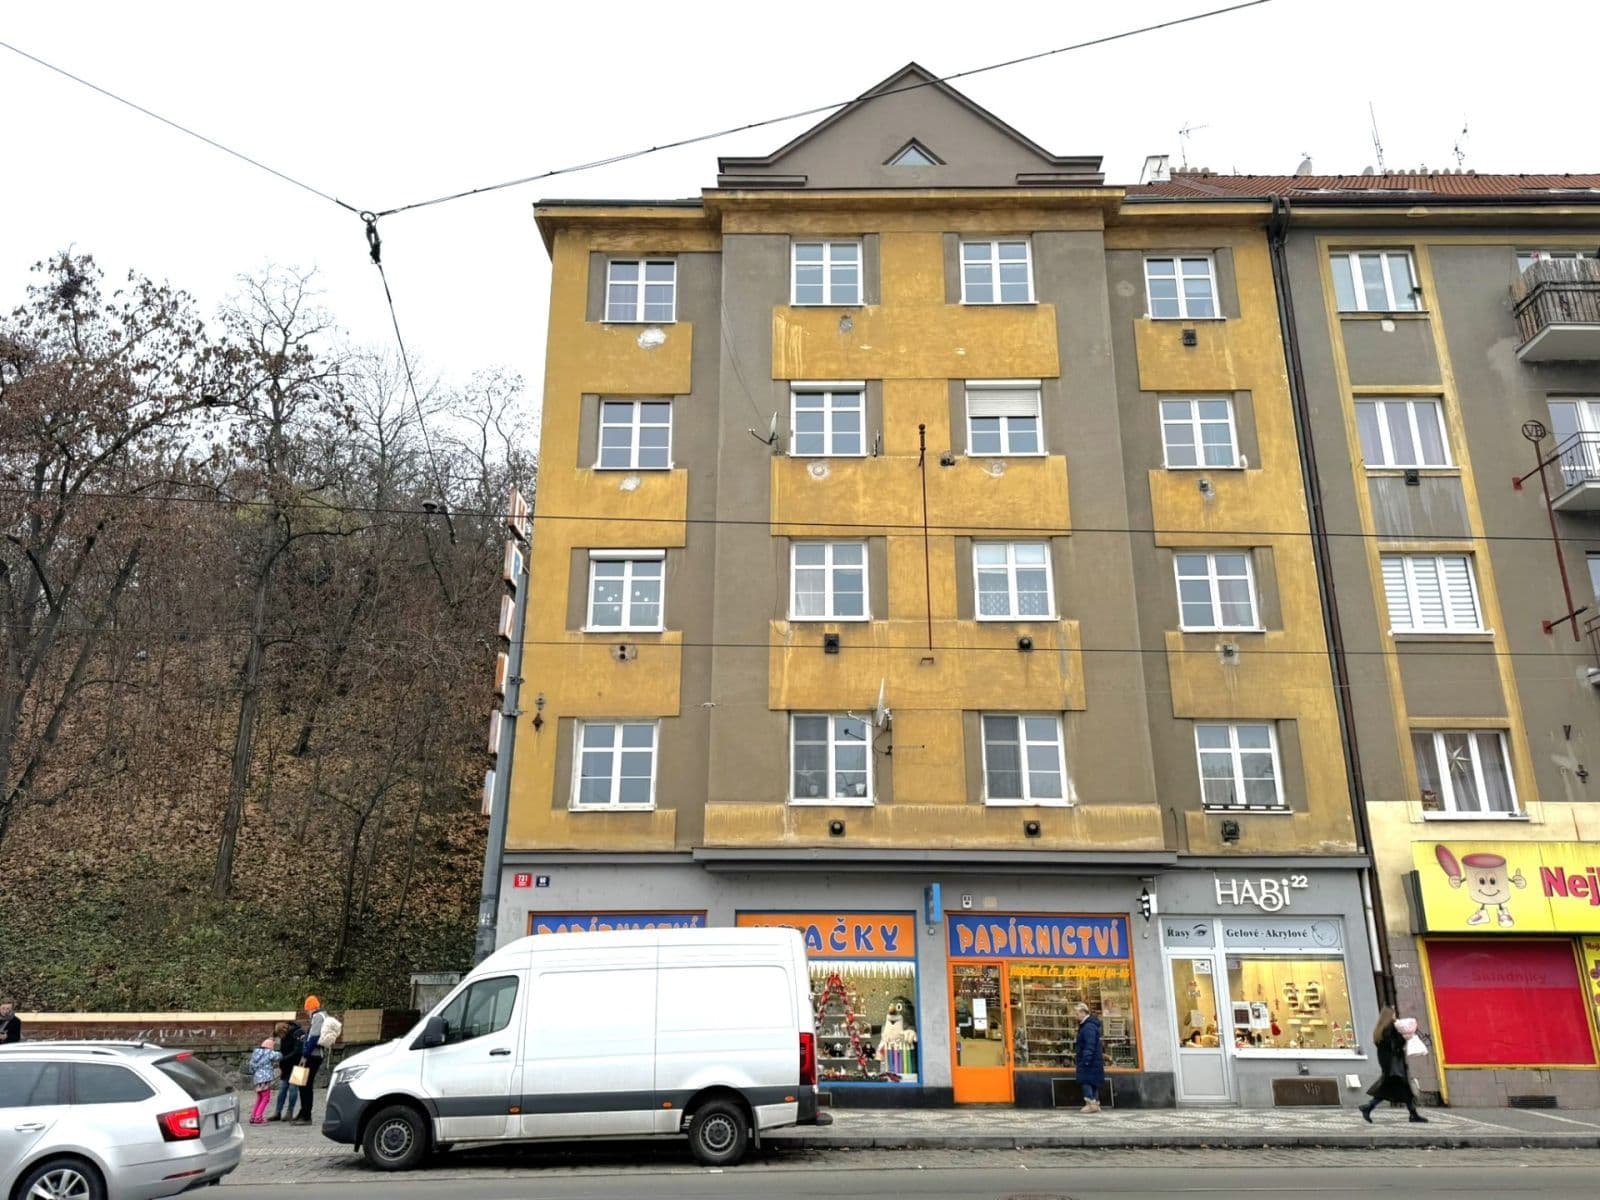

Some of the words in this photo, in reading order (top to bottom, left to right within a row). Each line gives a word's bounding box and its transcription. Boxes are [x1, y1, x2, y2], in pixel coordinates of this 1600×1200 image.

[754, 917, 899, 951] AČKY
[956, 917, 1119, 956] PAPÍRNICTVÍ
[1226, 927, 1259, 937] Gelové
[1265, 927, 1308, 939] Akrylové
